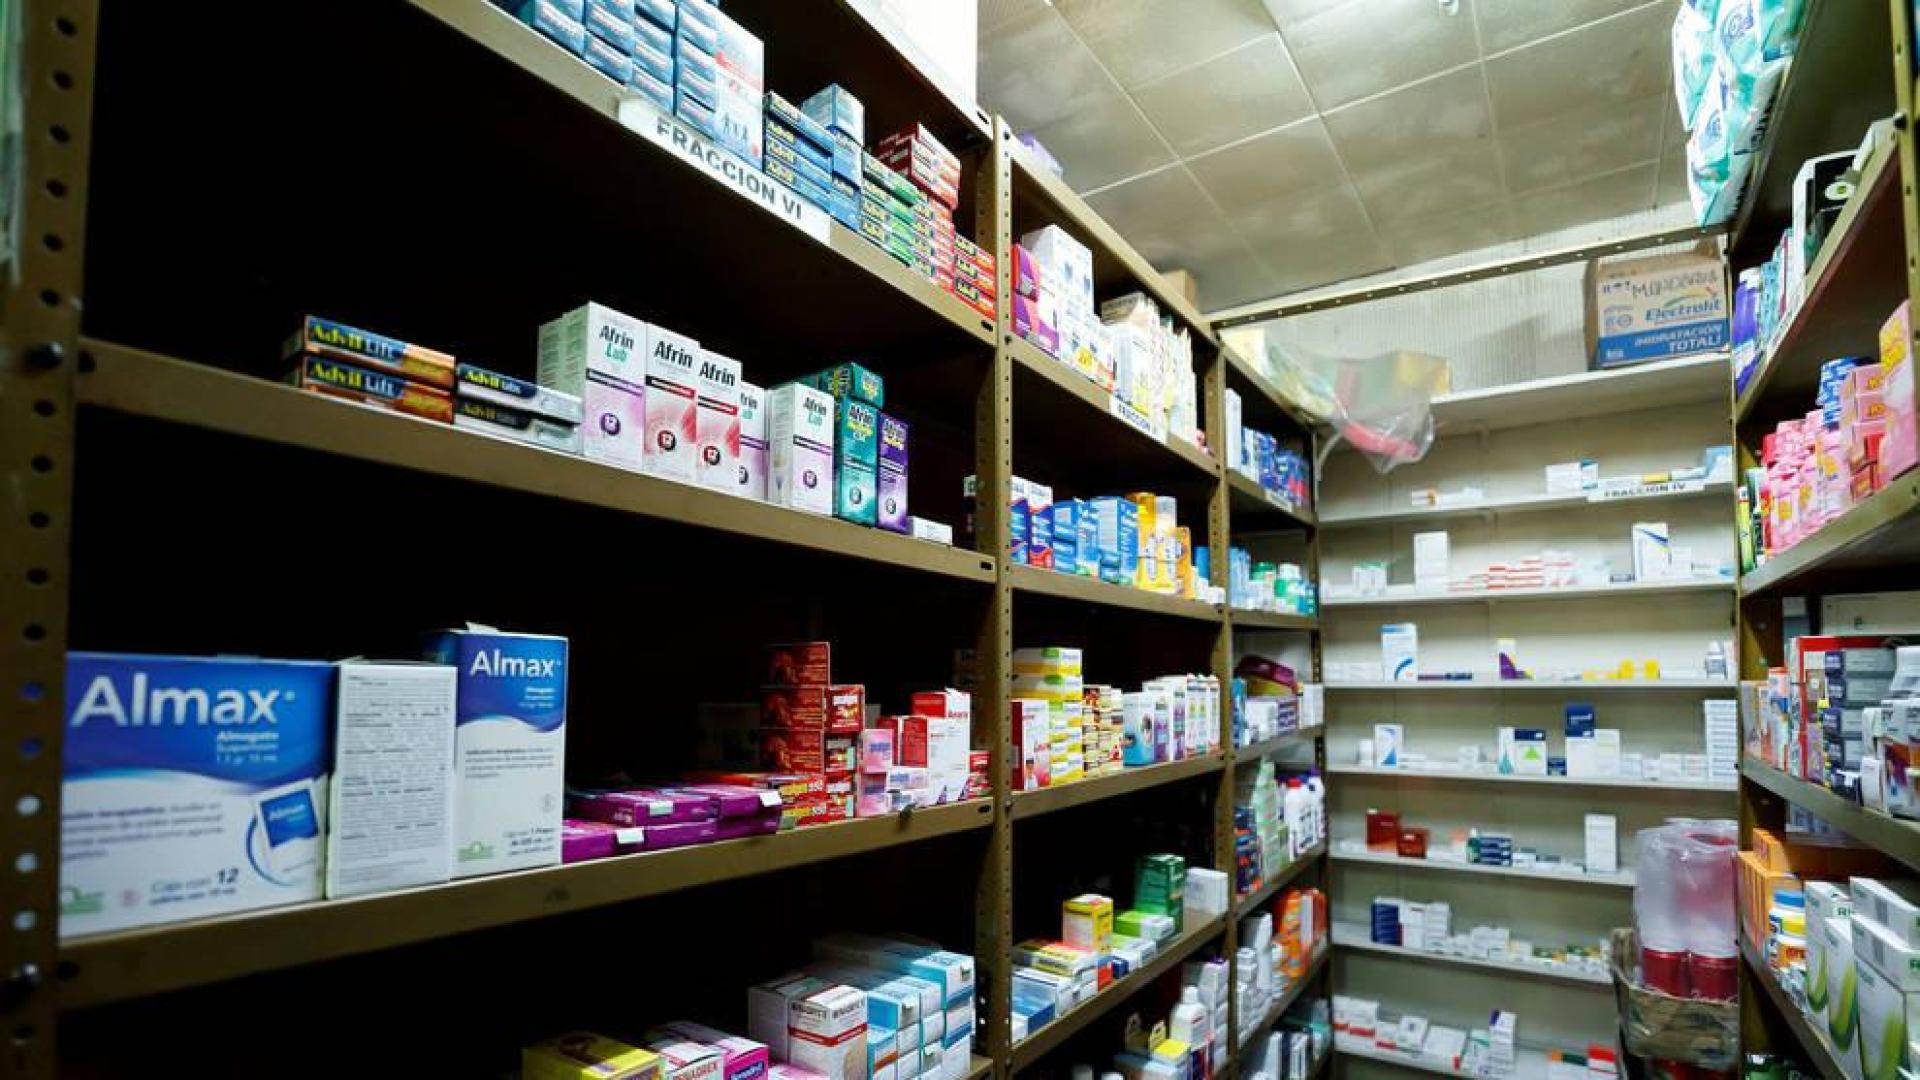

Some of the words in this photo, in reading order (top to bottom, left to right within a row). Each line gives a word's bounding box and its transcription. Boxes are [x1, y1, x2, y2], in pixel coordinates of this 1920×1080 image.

[656, 115, 775, 204] FRACCION
[782, 194, 802, 220] VI
[1645, 298, 1722, 321] Electrolit
[314, 324, 363, 350] Advil
[600, 324, 635, 351] Afrin
[654, 340, 694, 369] Afrin
[314, 361, 362, 388] Advil
[465, 370, 500, 389] Advil
[700, 361, 737, 387] Afrin
[804, 396, 828, 416] Afrin
[1604, 485, 1668, 498] FRACCION
[469, 649, 555, 679] Almax
[70, 673, 280, 728] Almax
[217, 867, 239, 885] 12
